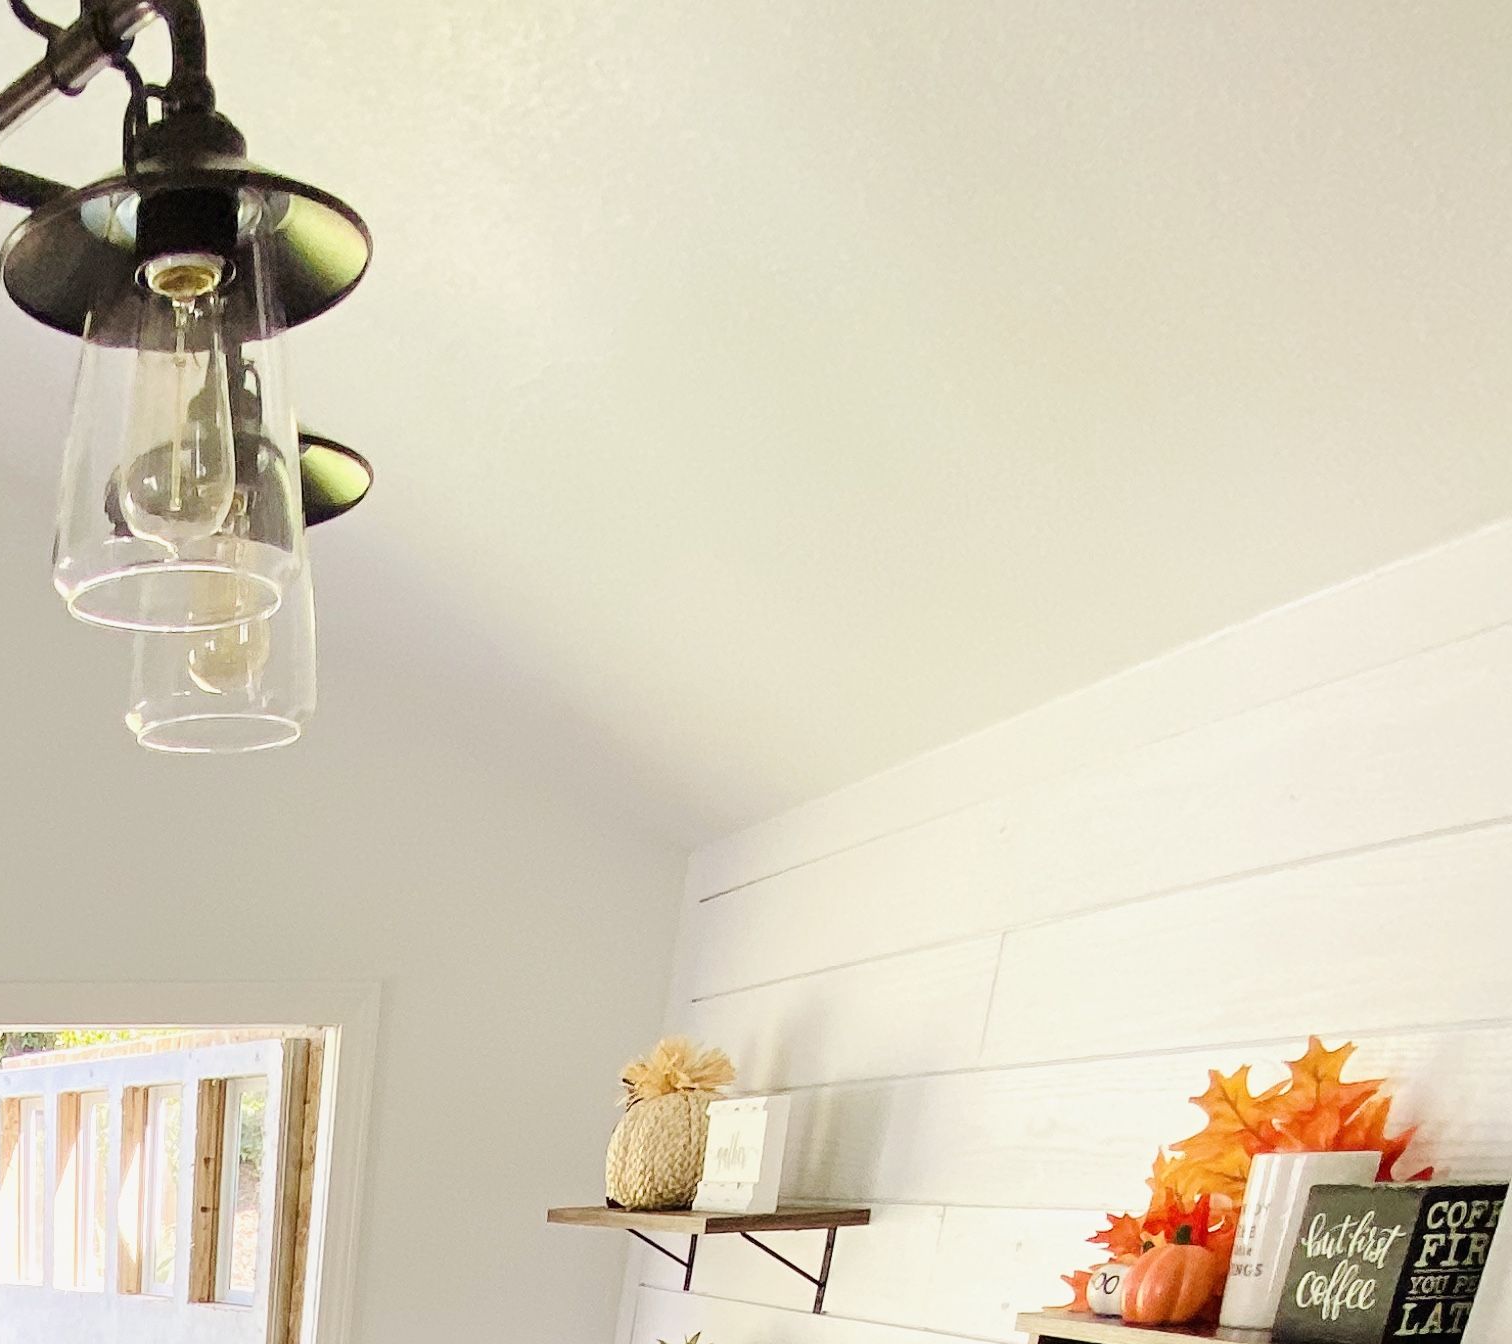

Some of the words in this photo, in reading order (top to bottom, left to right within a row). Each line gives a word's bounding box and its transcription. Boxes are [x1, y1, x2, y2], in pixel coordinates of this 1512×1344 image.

[1301, 1213, 1358, 1259] but
[1349, 1210, 1407, 1270] first
[1295, 1258, 1378, 1321] coffee
